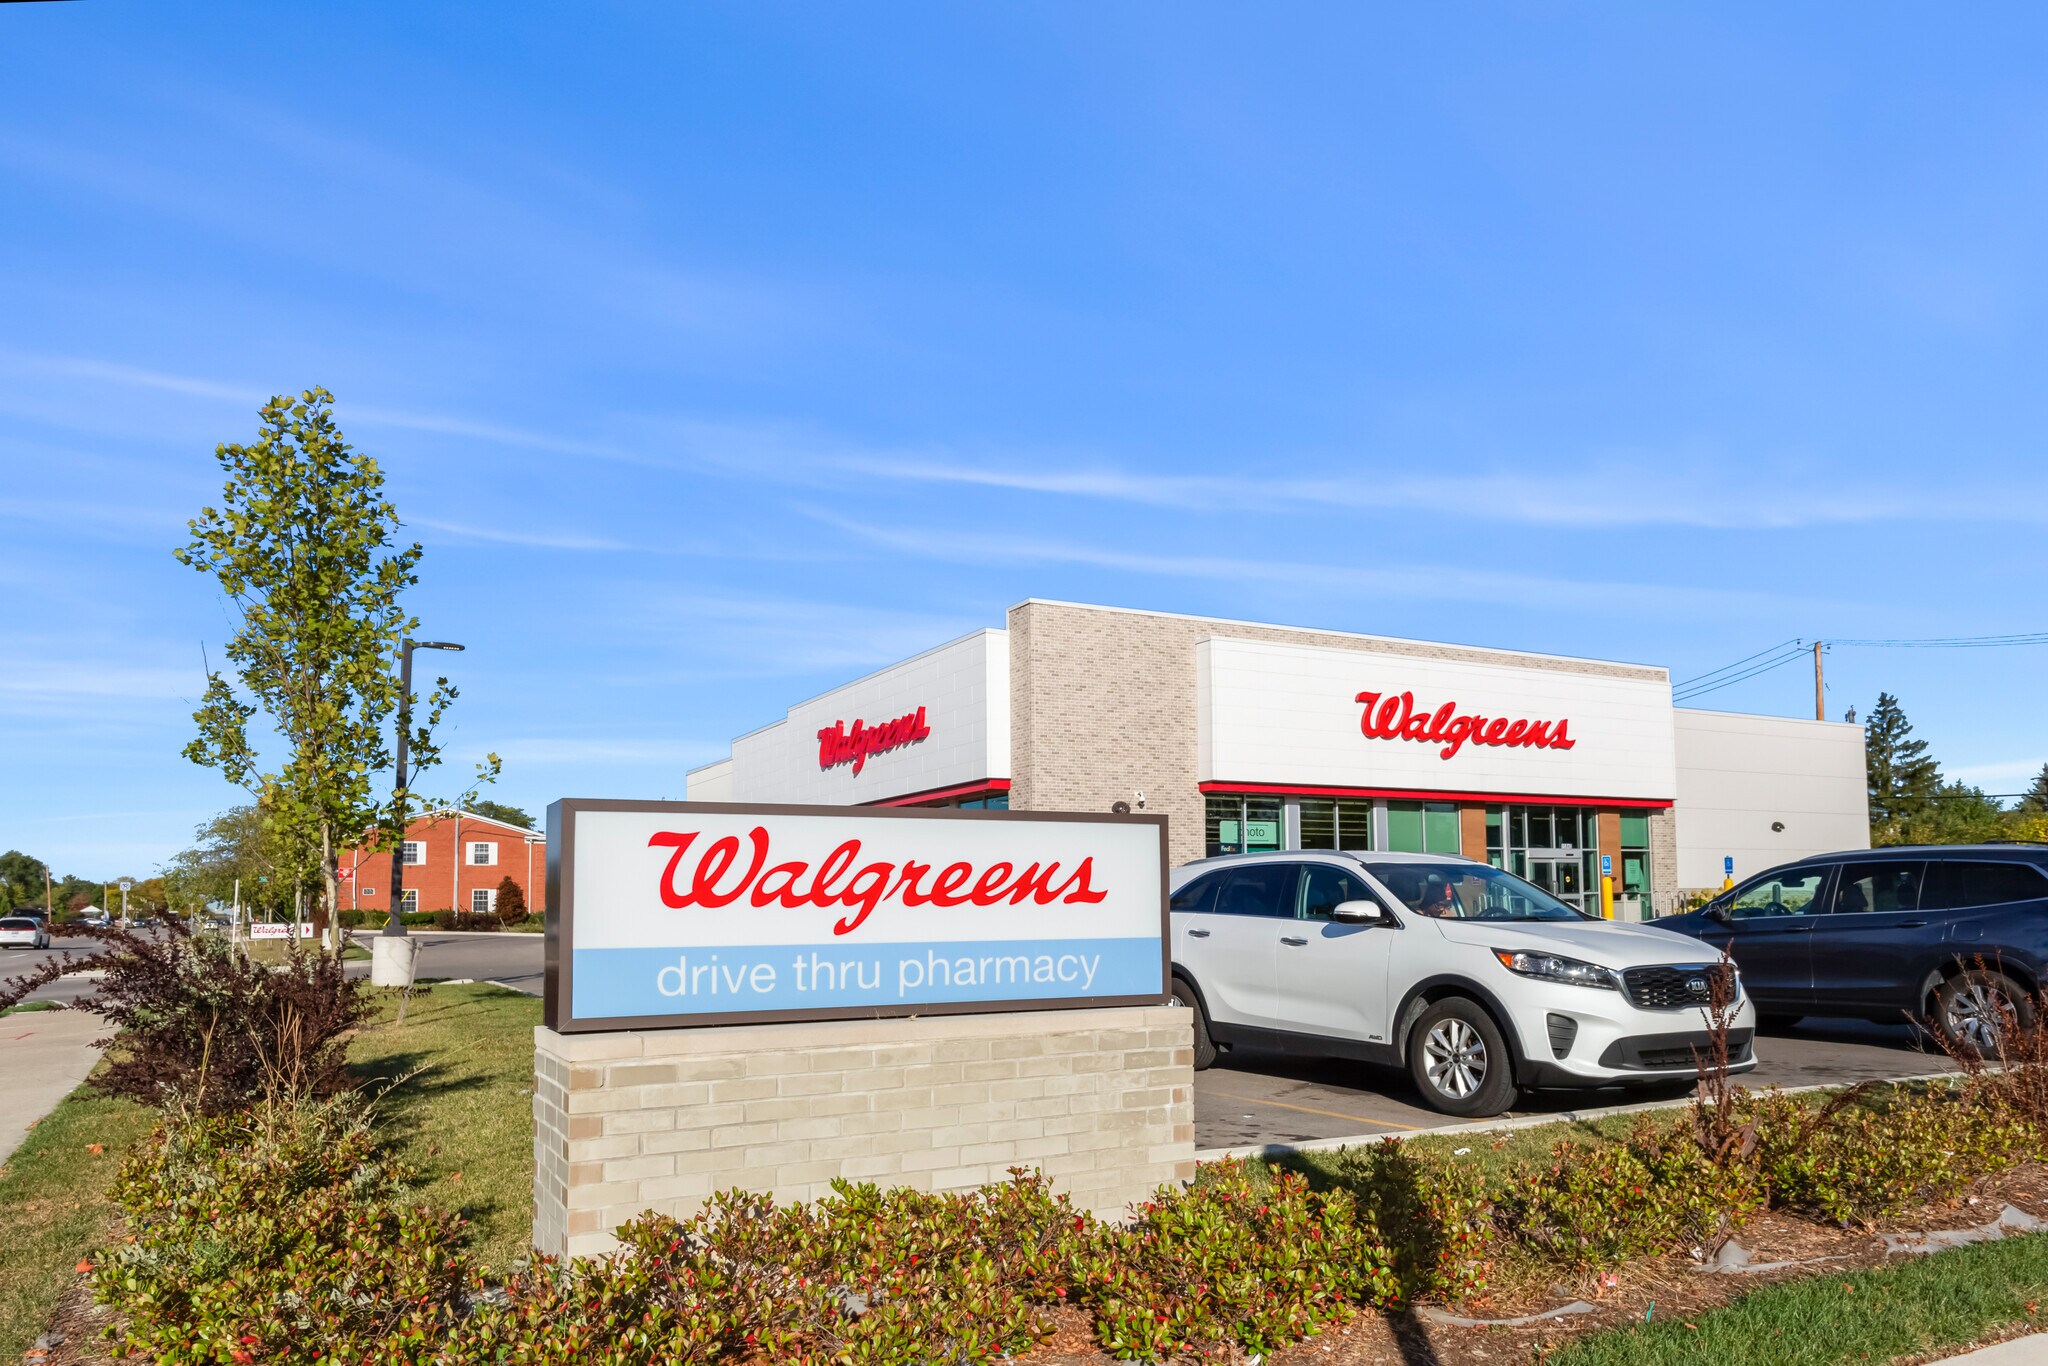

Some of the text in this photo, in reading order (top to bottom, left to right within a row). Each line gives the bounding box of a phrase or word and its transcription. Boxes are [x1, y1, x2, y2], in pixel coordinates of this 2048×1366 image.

[817, 706, 931, 775] Walgreens
[1354, 690, 1577, 760] Walgreens
[648, 825, 1109, 937] Walgreens
[657, 950, 1100, 997] drive thru pharmacy
[1691, 981, 1706, 991] KIA
